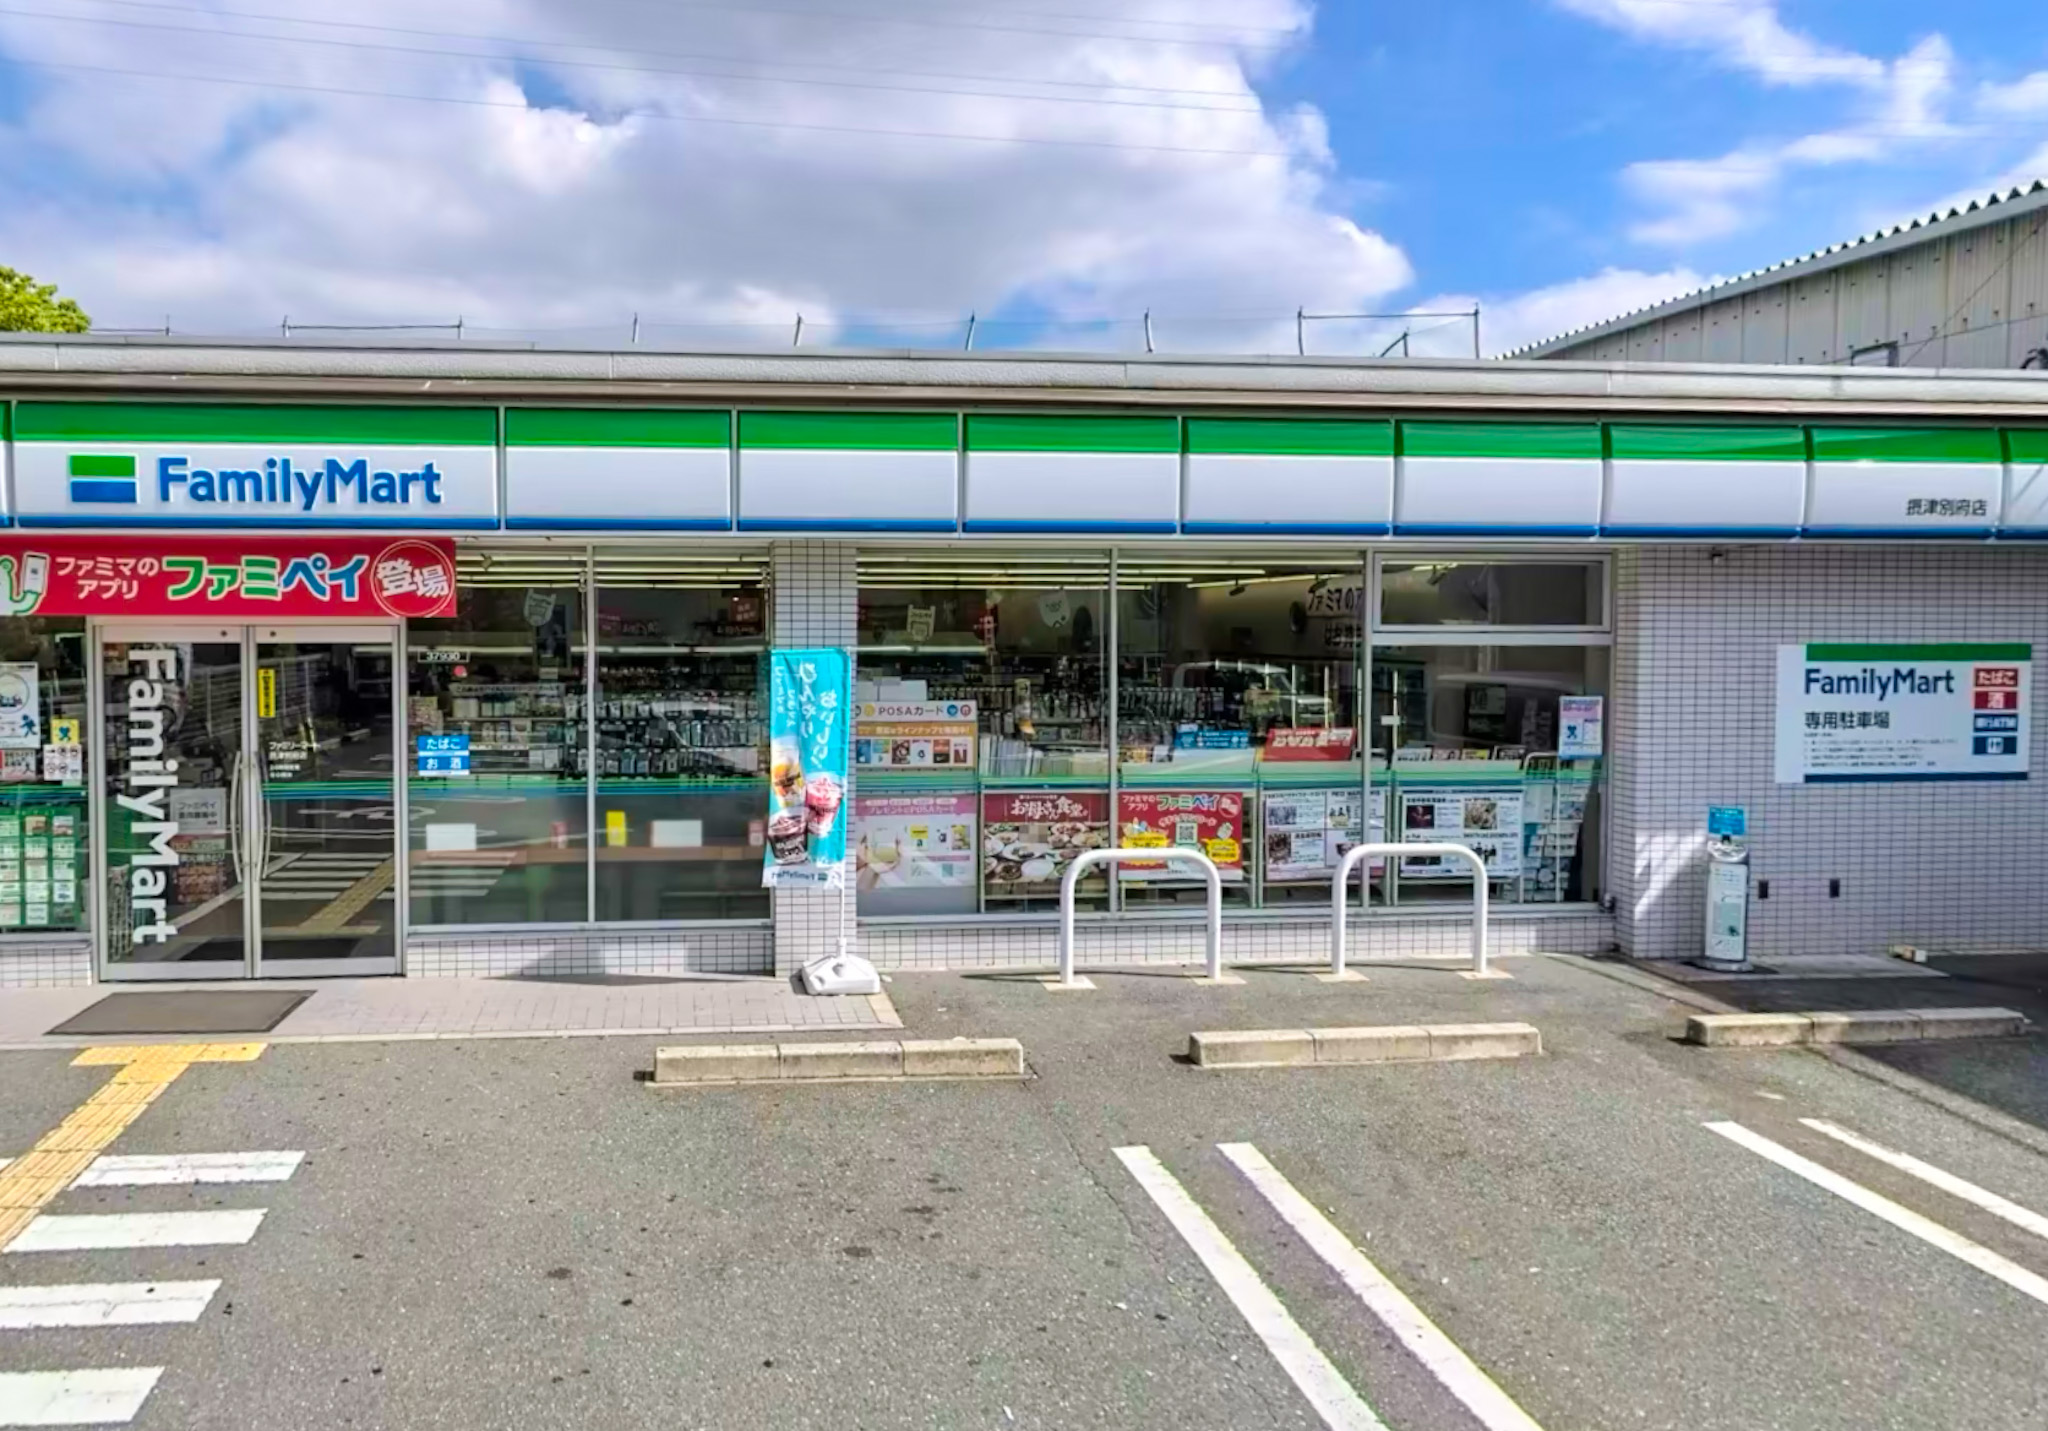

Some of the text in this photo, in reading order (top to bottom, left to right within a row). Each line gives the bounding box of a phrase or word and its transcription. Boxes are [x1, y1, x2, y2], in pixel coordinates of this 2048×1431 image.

[157, 457, 442, 511] FamilyMart
[1906, 498, 1986, 516] 摂津別府店
[56, 556, 158, 576] ファミマの
[162, 553, 369, 601] ファミペイ
[376, 559, 450, 599] 登場
[77, 579, 140, 599] アプリ
[426, 651, 461, 662] 37930
[1804, 667, 1955, 701] FamilyMart
[1977, 670, 2016, 685] たばこ
[1986, 691, 2005, 709] 酒
[879, 705, 944, 716] POSAカード
[1804, 711, 1890, 729] 専用駐車場
[426, 738, 461, 750] たばこ
[116, 648, 179, 944] FamilyMart
[1121, 794, 1156, 804] ファミマの
[1157, 794, 1220, 812] ファミペイ
[1127, 803, 1149, 812] アプリ
